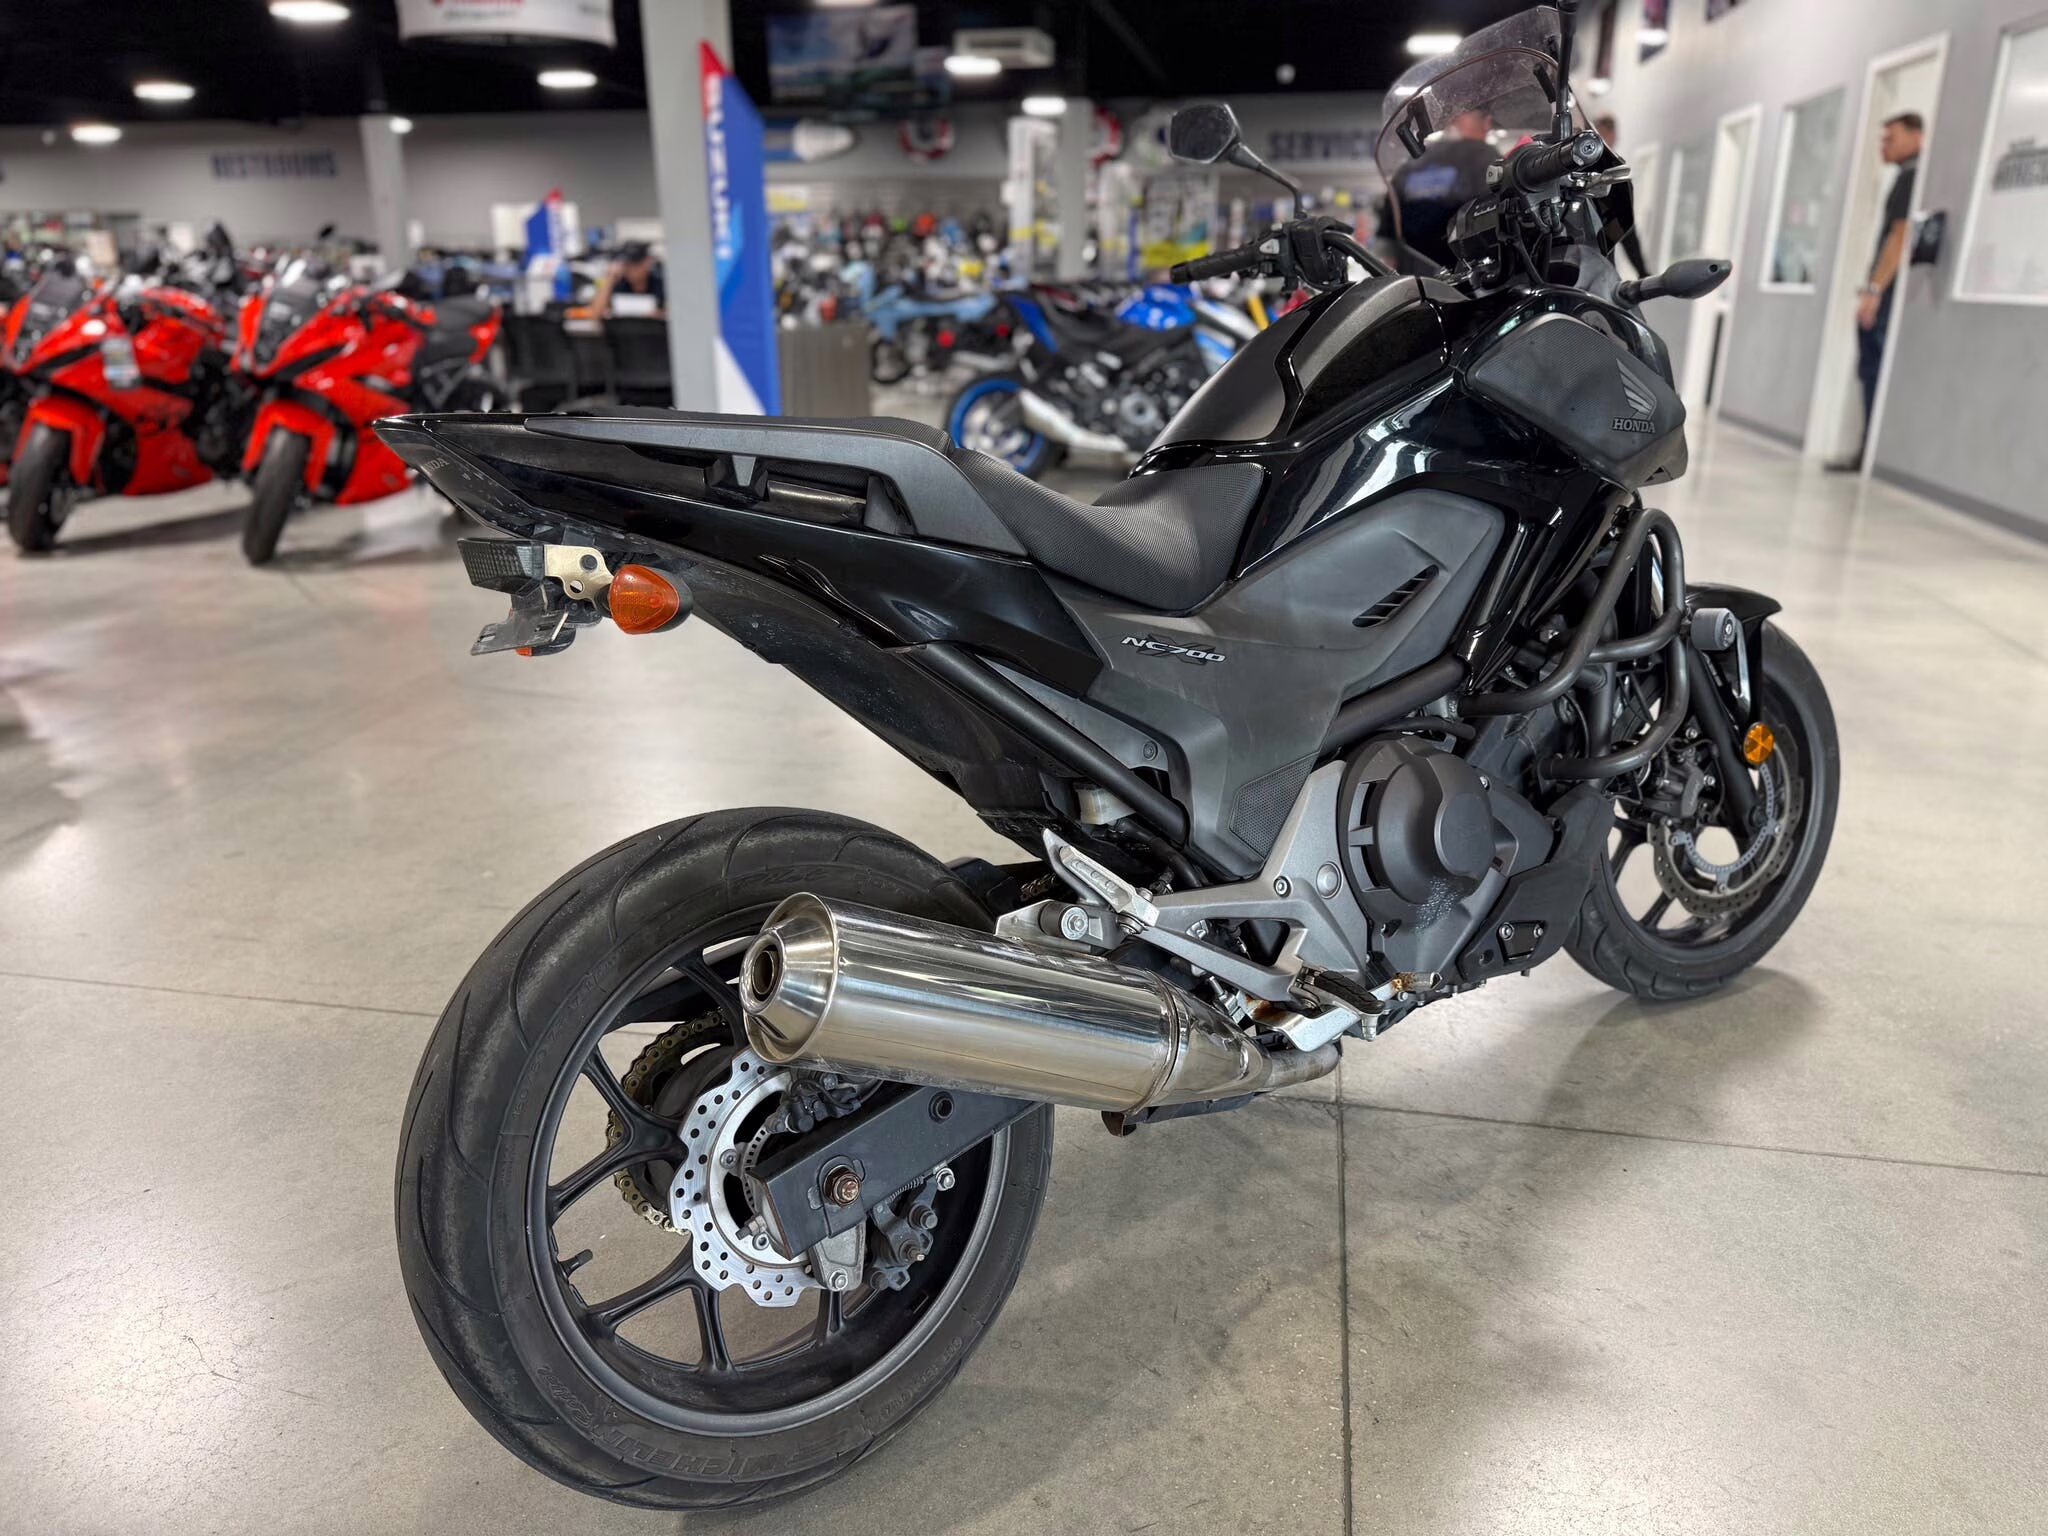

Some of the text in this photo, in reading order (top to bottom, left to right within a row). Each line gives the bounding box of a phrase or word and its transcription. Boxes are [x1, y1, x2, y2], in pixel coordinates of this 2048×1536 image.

[1612, 417, 1656, 434] HONDA
[1121, 636, 1226, 662] NC700
[591, 1424, 781, 1477] MICHELIN
